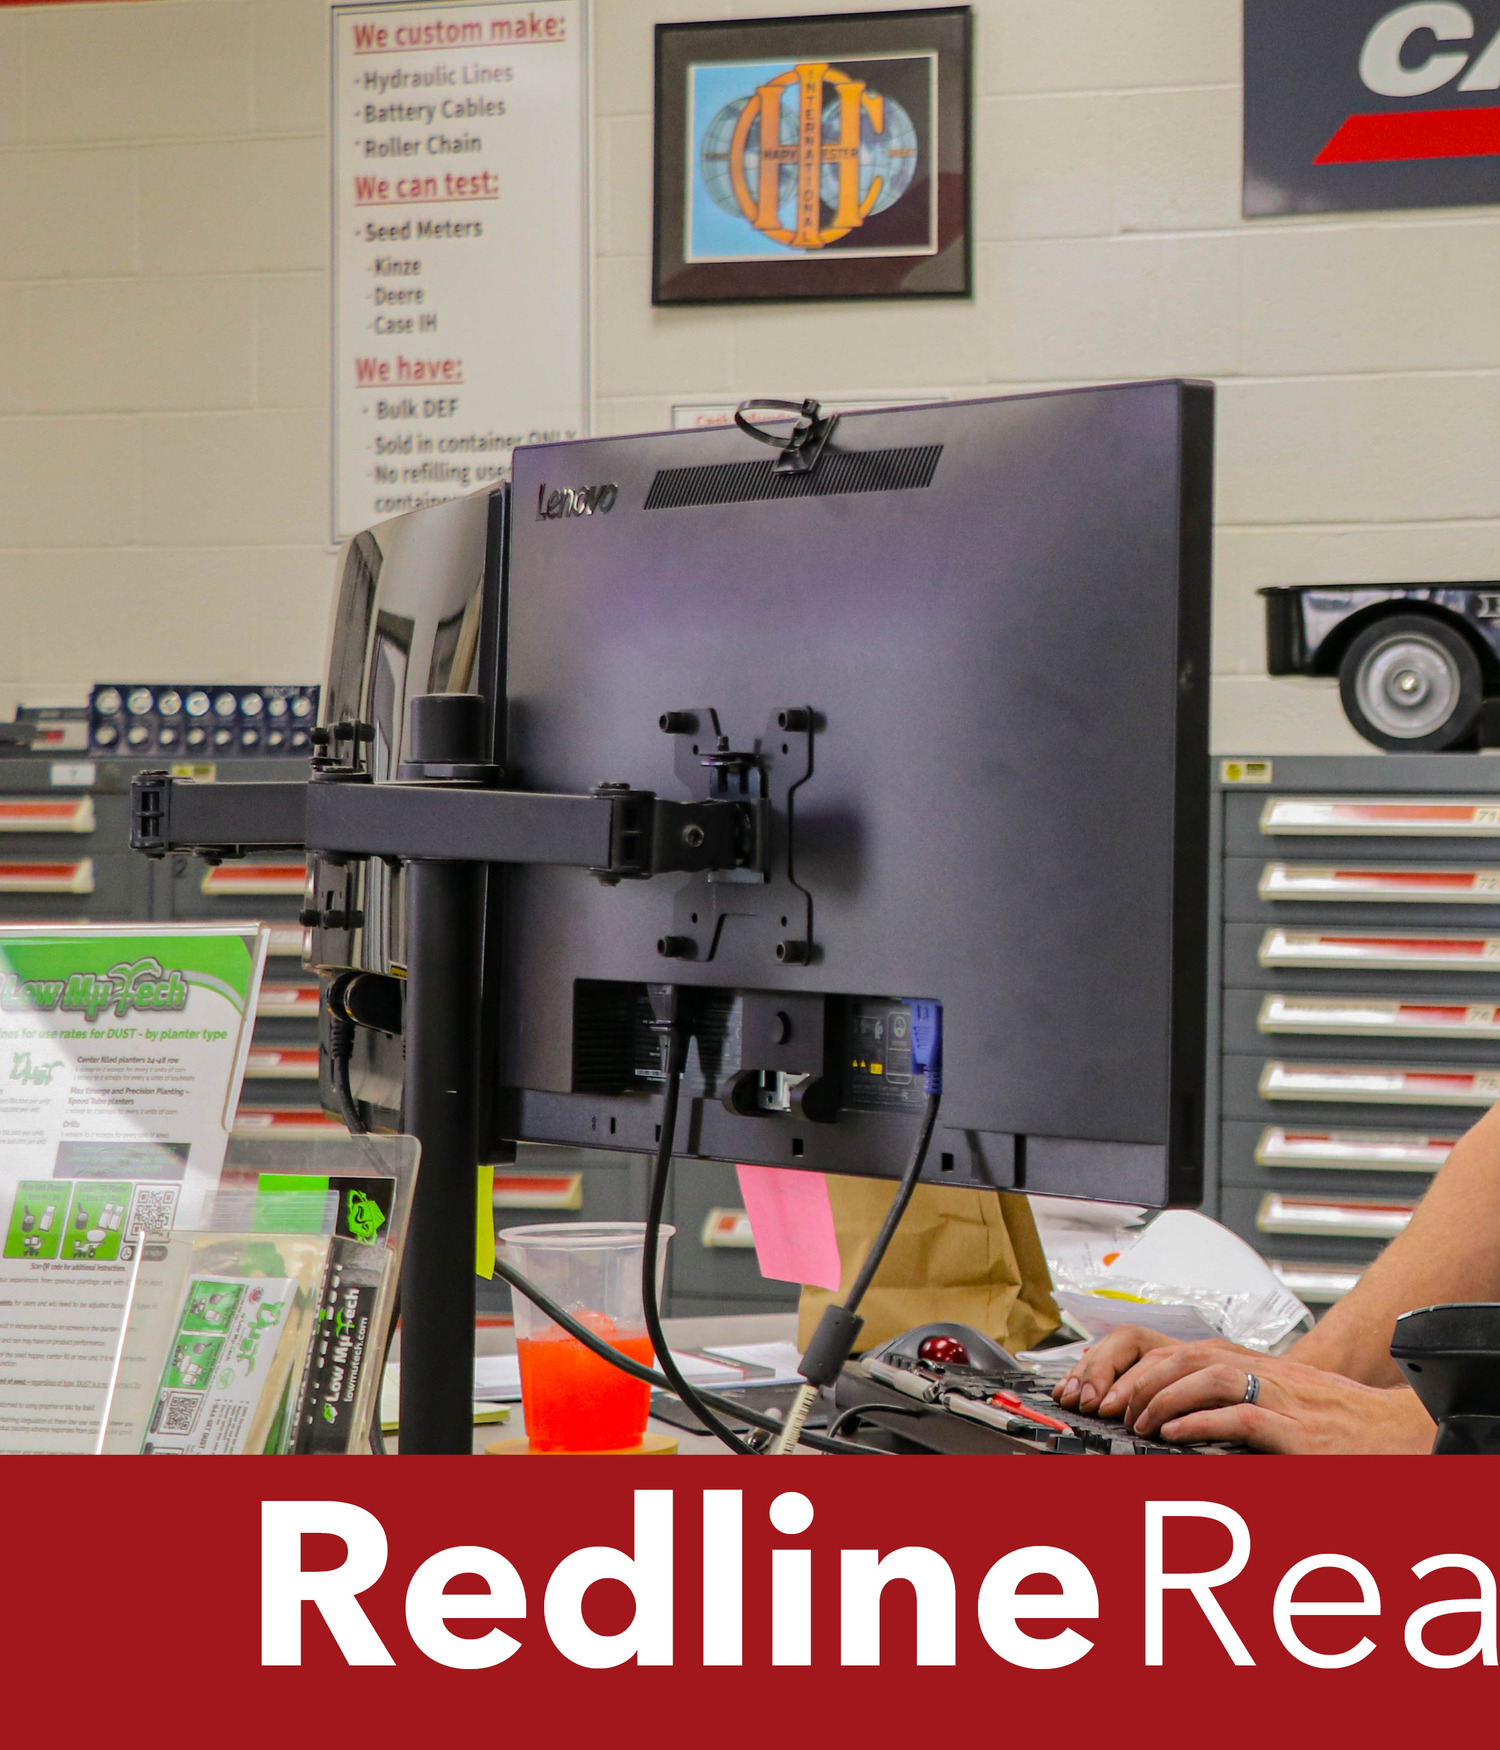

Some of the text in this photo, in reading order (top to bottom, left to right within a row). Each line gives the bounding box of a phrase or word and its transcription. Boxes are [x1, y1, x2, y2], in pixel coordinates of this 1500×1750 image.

[353, 12, 567, 50] We custom make:
[363, 65, 514, 95] Hydraulic Lines
[363, 98, 506, 125] Battery Cables
[364, 132, 483, 159] Roller Chain
[354, 172, 499, 201] We can test:
[365, 219, 484, 243] Seed Meters
[373, 257, 422, 277] Kinze
[373, 286, 424, 306] Deere
[374, 313, 438, 335] Case IH
[355, 355, 464, 382] We have:
[376, 398, 459, 420] Bulk DEF
[374, 434, 413, 455] Sold
[416, 431, 434, 453] in
[437, 430, 522, 454] container
[374, 465, 398, 484] No
[402, 461, 472, 488] refilling
[535, 482, 619, 522] Lenovo
[60, 1028, 87, 1040] rates
[90, 1028, 105, 1040] for
[107, 1028, 137, 1040] DUST
[146, 1028, 160, 1042] by
[161, 1028, 201, 1042] planter
[203, 1028, 228, 1042] type
[343, 1316, 370, 1403] lowmutech.com
[324, 1366, 346, 1403] Low
